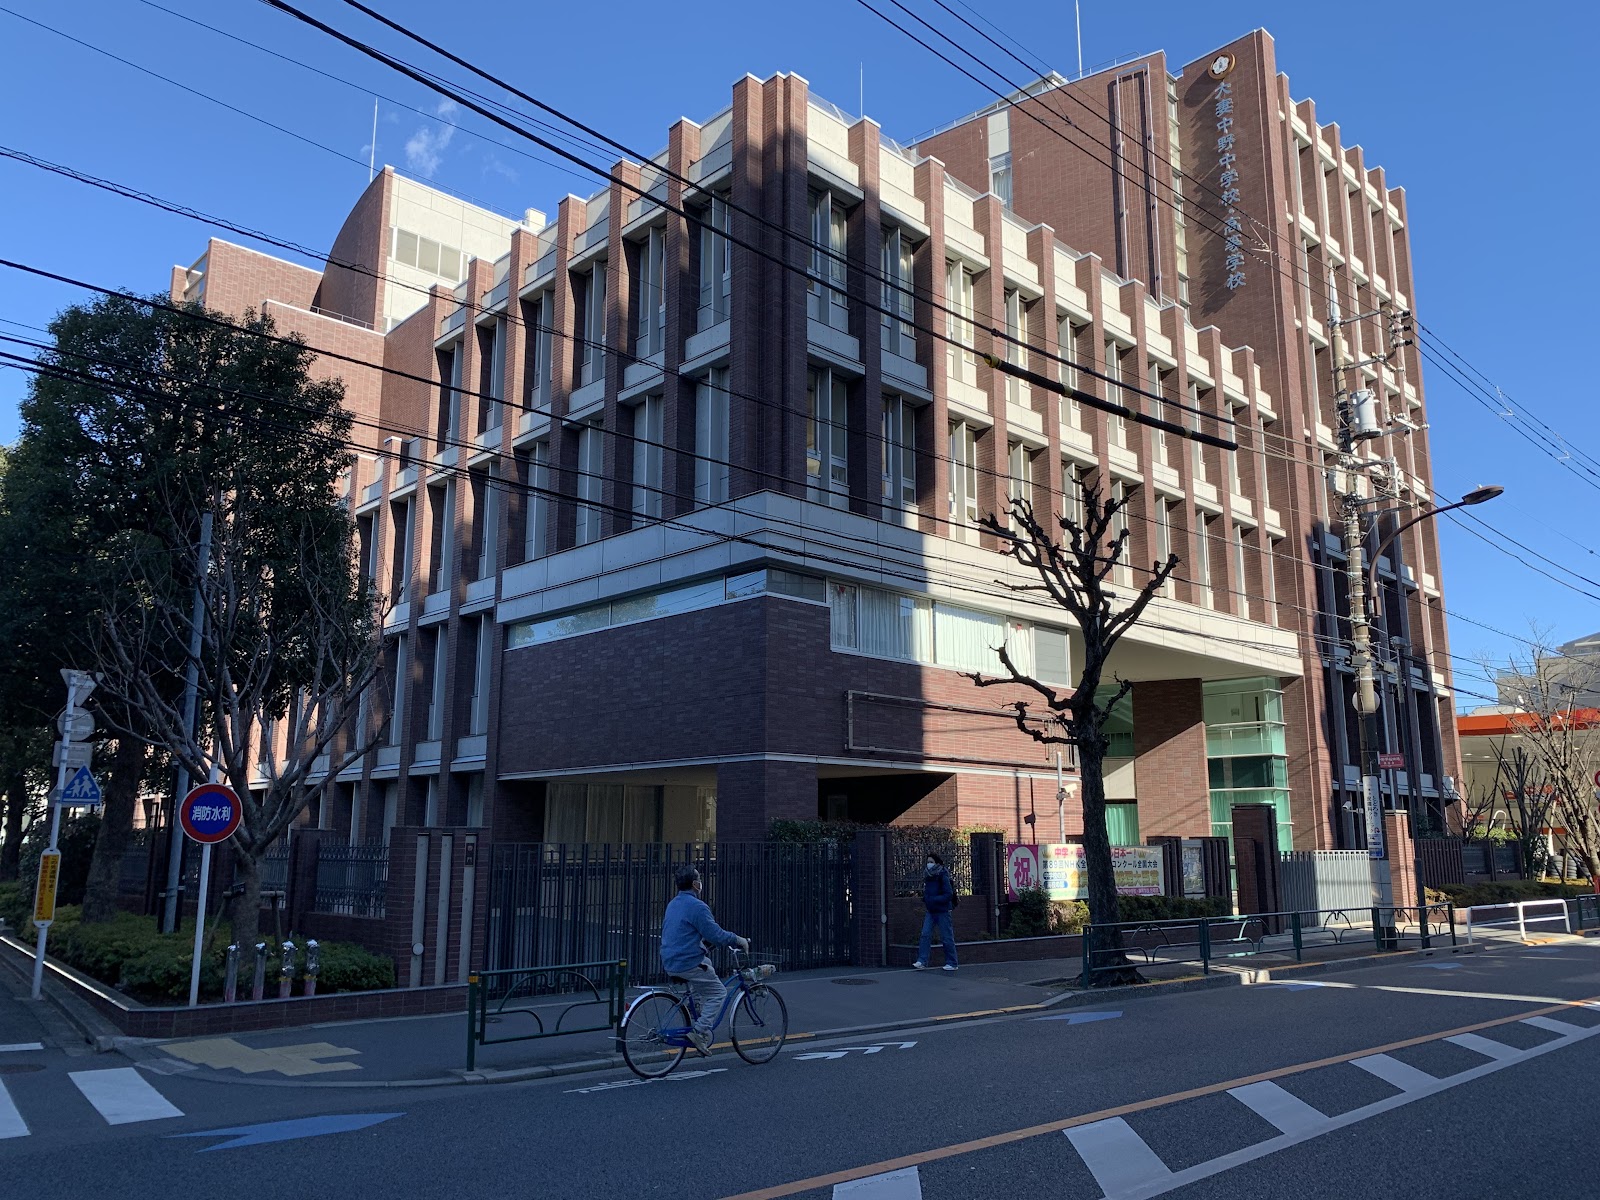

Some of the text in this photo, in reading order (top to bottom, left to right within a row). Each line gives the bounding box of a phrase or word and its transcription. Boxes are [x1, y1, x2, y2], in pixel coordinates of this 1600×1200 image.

[1214, 81, 1247, 290] 大妻中野中学校・高等学校
[191, 805, 231, 821] 消防水利
[1013, 856, 1032, 888] 祝
